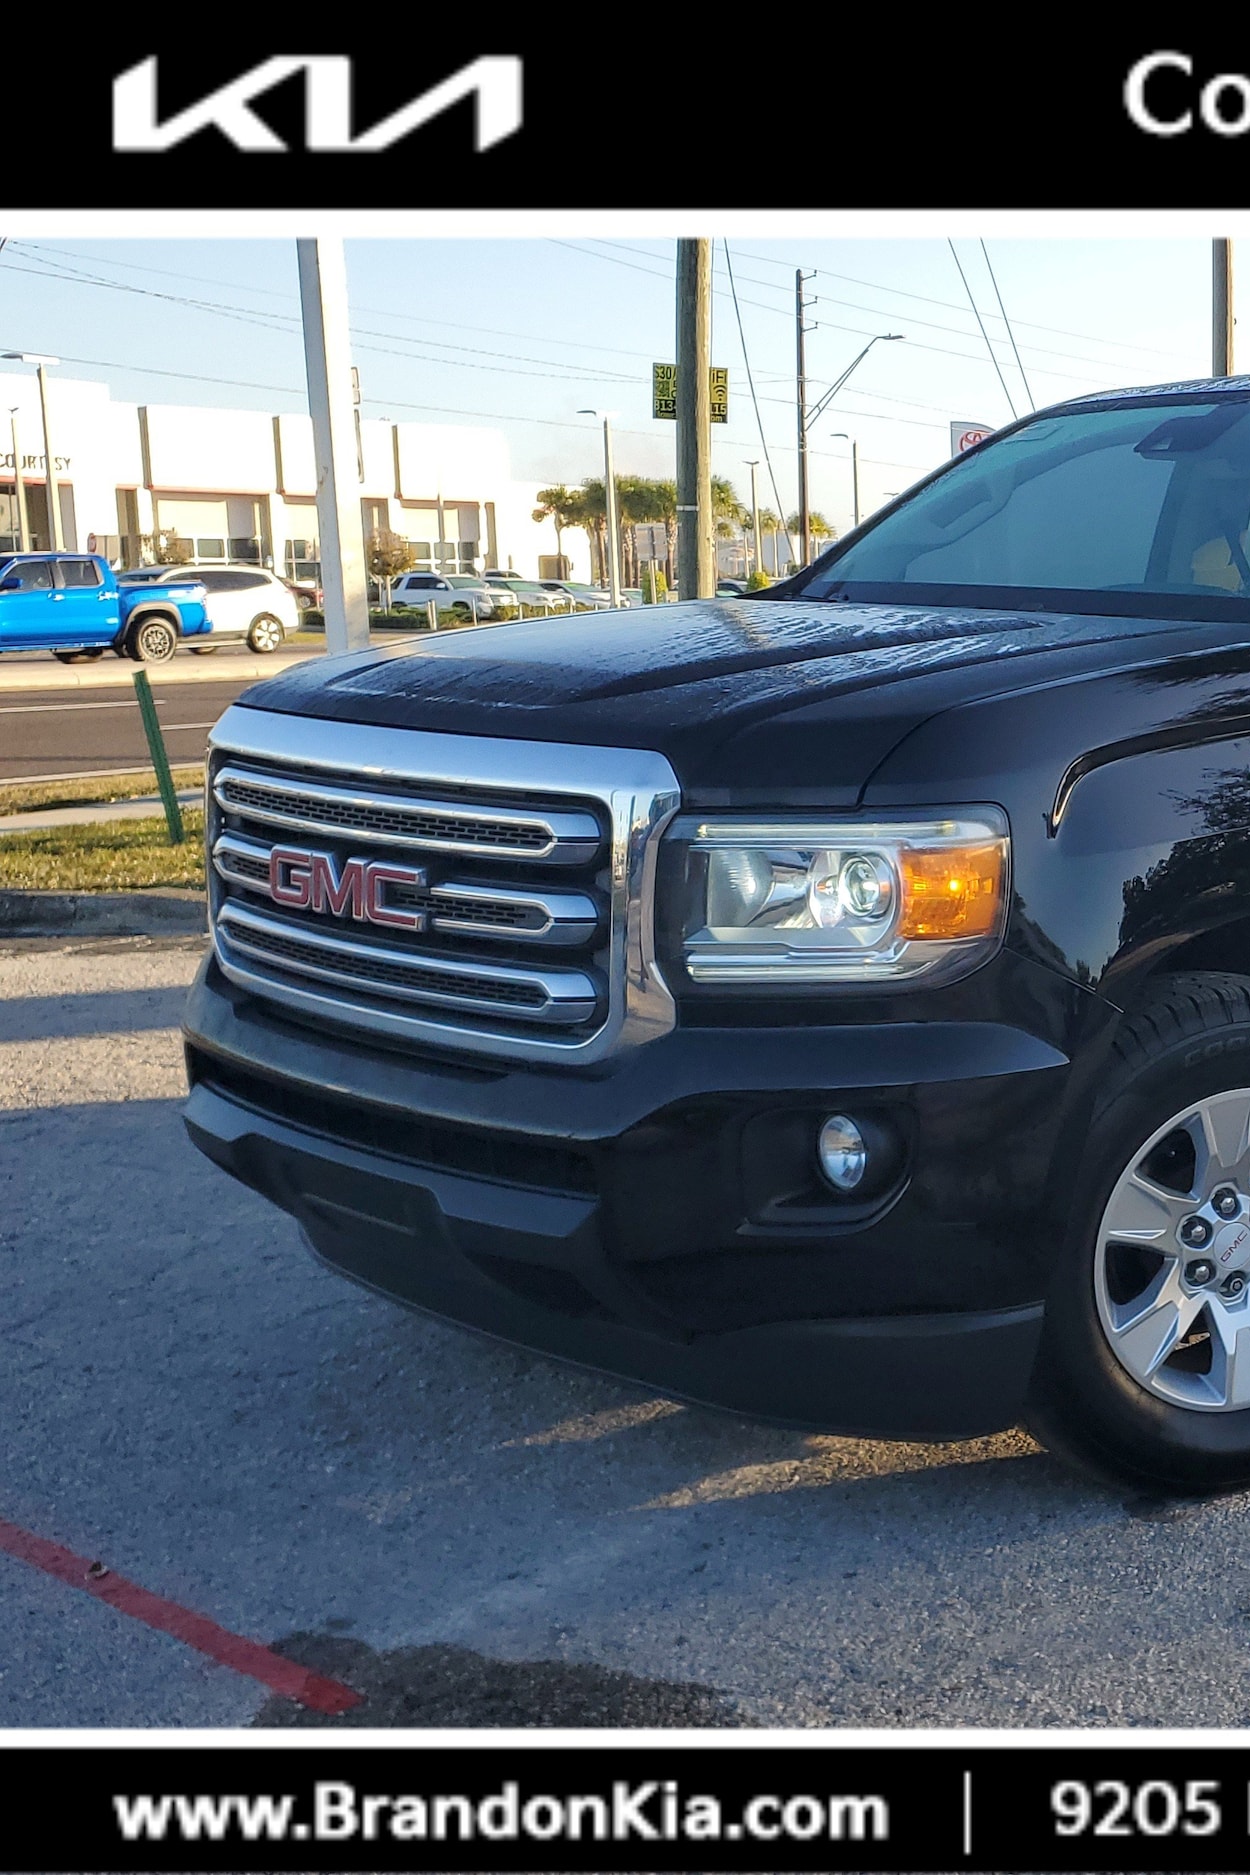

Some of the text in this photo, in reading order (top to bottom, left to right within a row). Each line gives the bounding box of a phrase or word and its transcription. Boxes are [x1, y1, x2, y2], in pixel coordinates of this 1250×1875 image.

[0, 453, 71, 471] COURTSY
[270, 844, 427, 932] GMC
[1220, 1229, 1248, 1263] GMC
